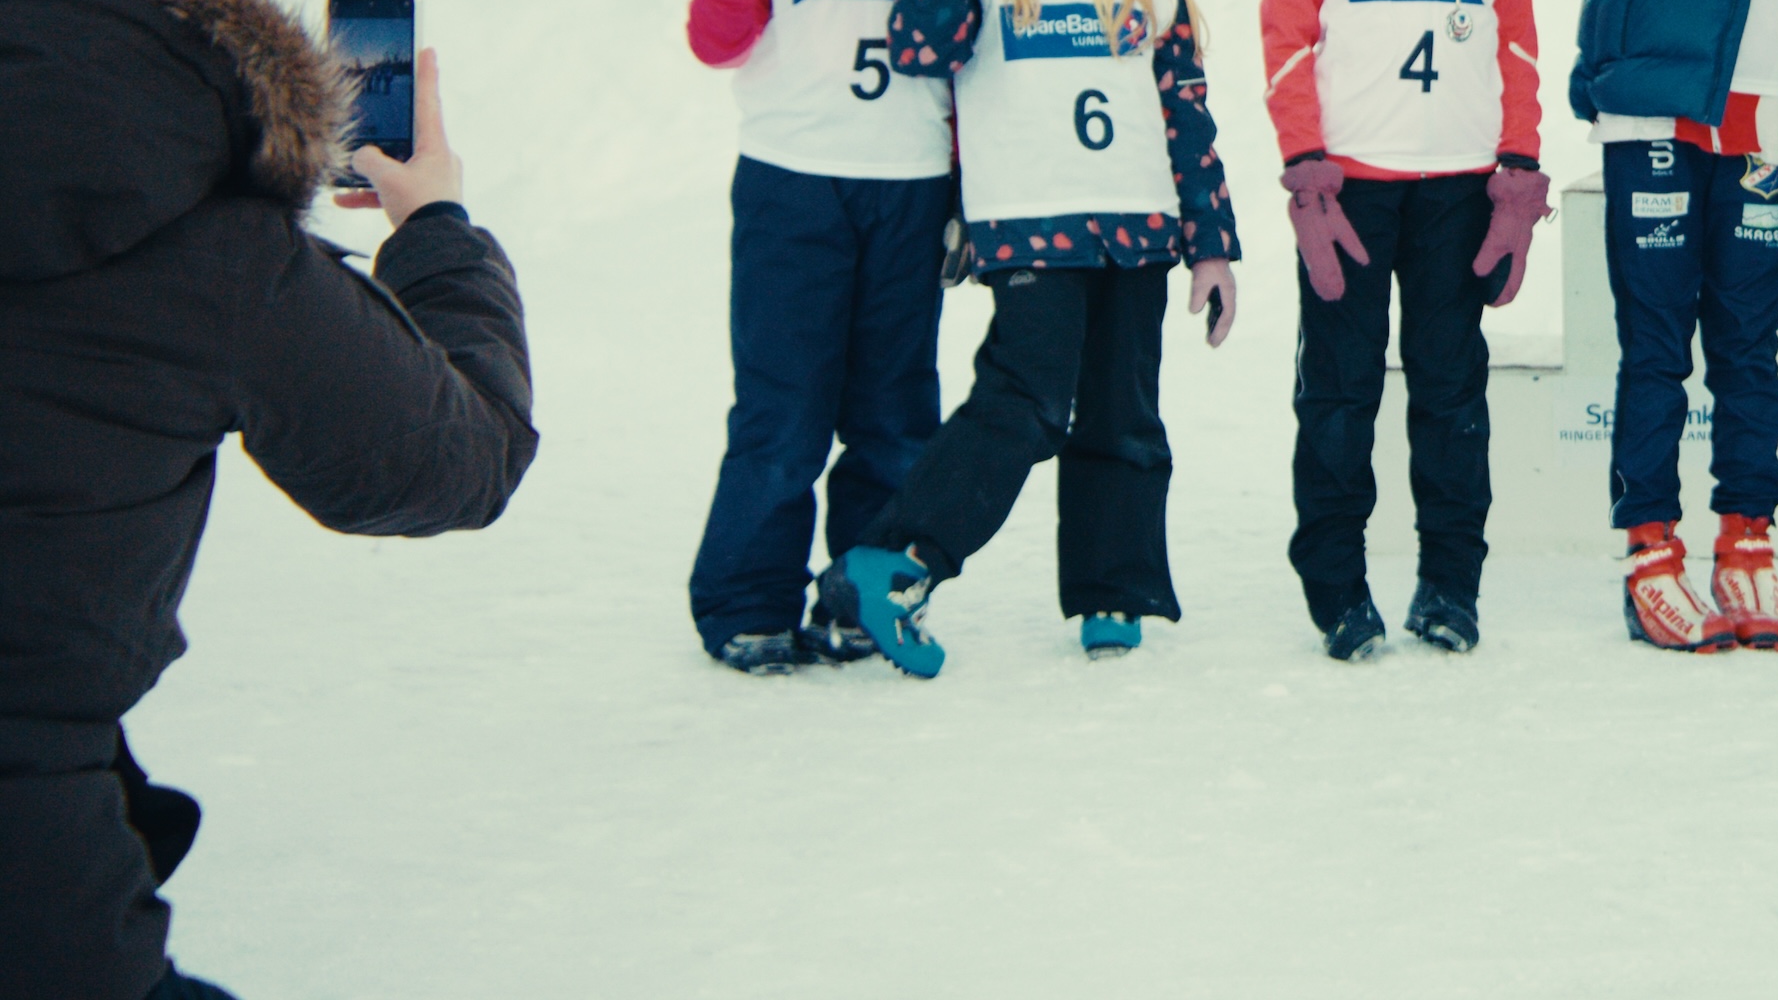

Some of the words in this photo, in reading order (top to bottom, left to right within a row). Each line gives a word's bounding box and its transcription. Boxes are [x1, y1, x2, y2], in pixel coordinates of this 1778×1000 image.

[1013, 13, 1108, 39] pareBan
[1072, 35, 1105, 47] LUNN
[849, 38, 891, 101] 5
[1398, 29, 1439, 93] 4
[1073, 88, 1114, 151] 6
[1635, 196, 1671, 206] FRAM
[1559, 430, 1613, 442] RINGER
[1639, 583, 1696, 636] alpina
